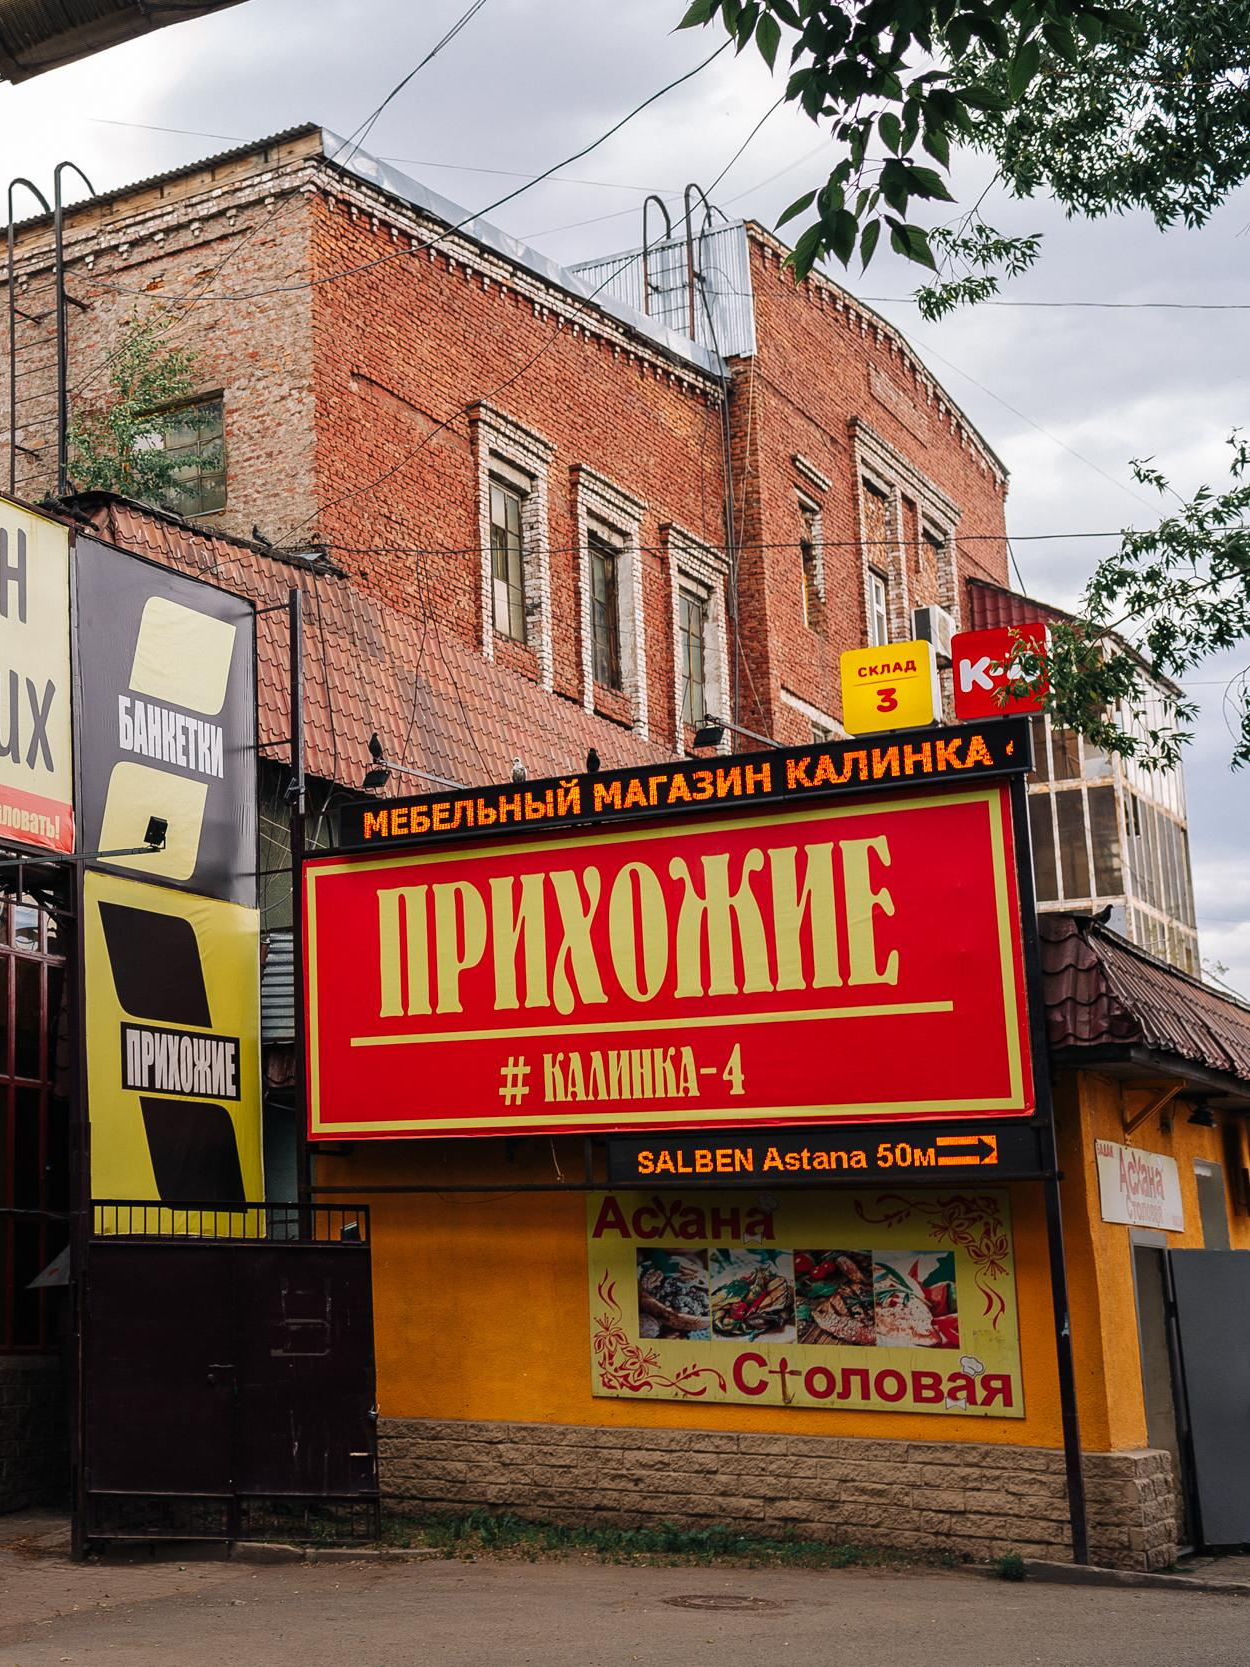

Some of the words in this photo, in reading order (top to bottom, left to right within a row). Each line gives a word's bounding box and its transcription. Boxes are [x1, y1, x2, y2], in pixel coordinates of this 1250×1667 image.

[858, 660, 917, 678] СКЛАД
[876, 688, 898, 713] 3
[118, 694, 224, 779] БАНКЕТКИ
[363, 779, 581, 840] МЕБЕЛЬНЫЙ
[592, 762, 774, 814] МАГАЗИН
[785, 734, 993, 790] КАЛИНКА
[377, 835, 899, 1019] ПРИХОЖИЕ
[126, 1028, 236, 1097] ПРИХОЖИЕ
[543, 1043, 745, 1102] КАЛИНКА-4
[637, 1148, 753, 1174] SALBEN
[762, 1145, 867, 1171] Astana
[592, 1194, 775, 1241] Асхана
[732, 1351, 1014, 1407] Столовая
